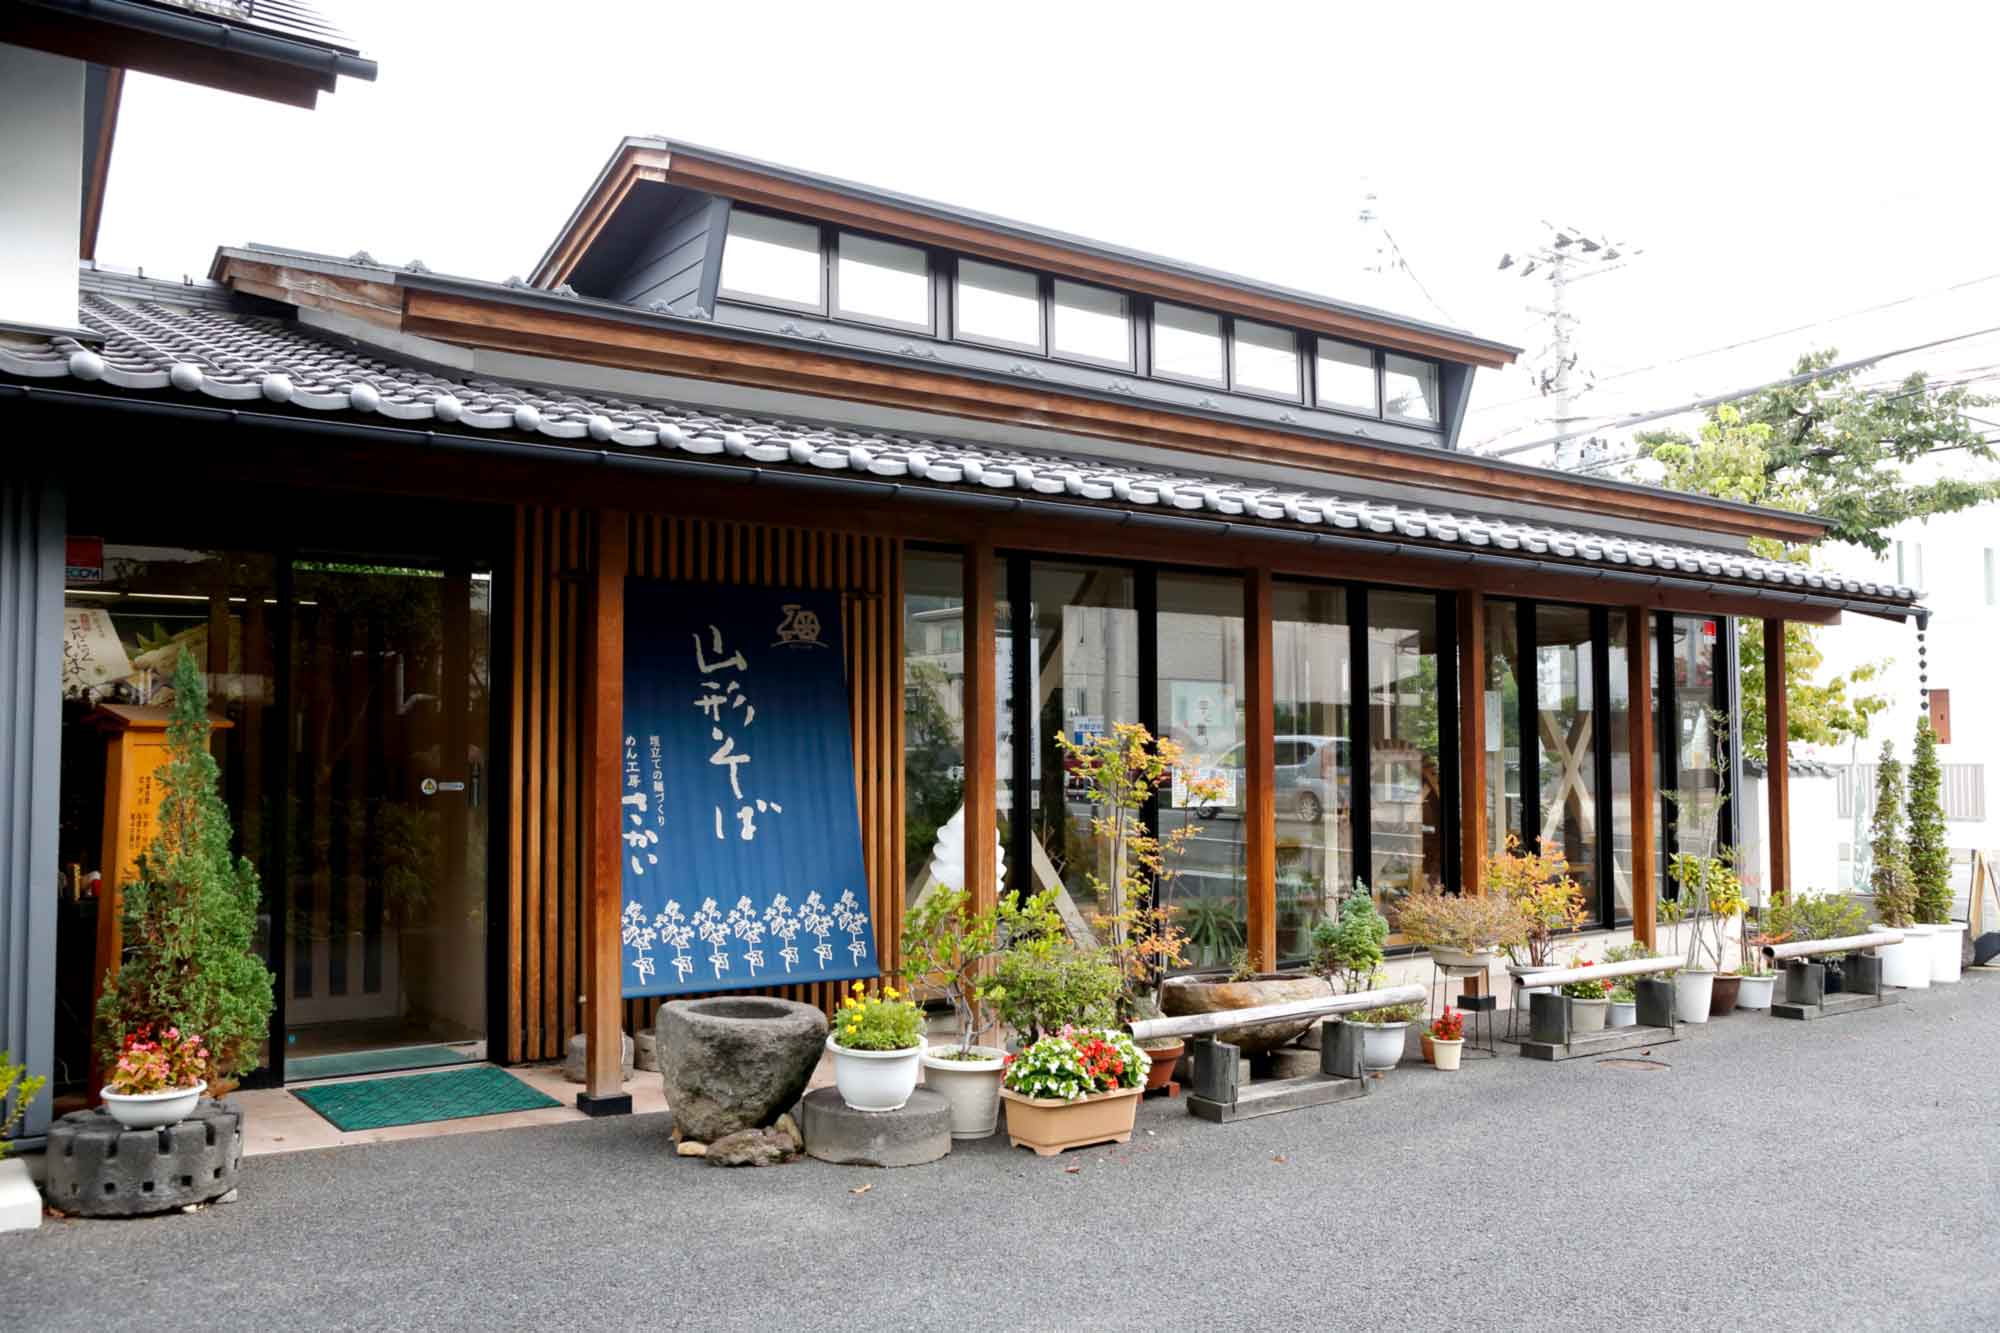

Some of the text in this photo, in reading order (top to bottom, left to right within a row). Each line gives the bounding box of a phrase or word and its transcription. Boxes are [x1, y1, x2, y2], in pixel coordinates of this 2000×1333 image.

[65, 567, 98, 579] ECOM
[691, 624, 782, 840] 山形そば
